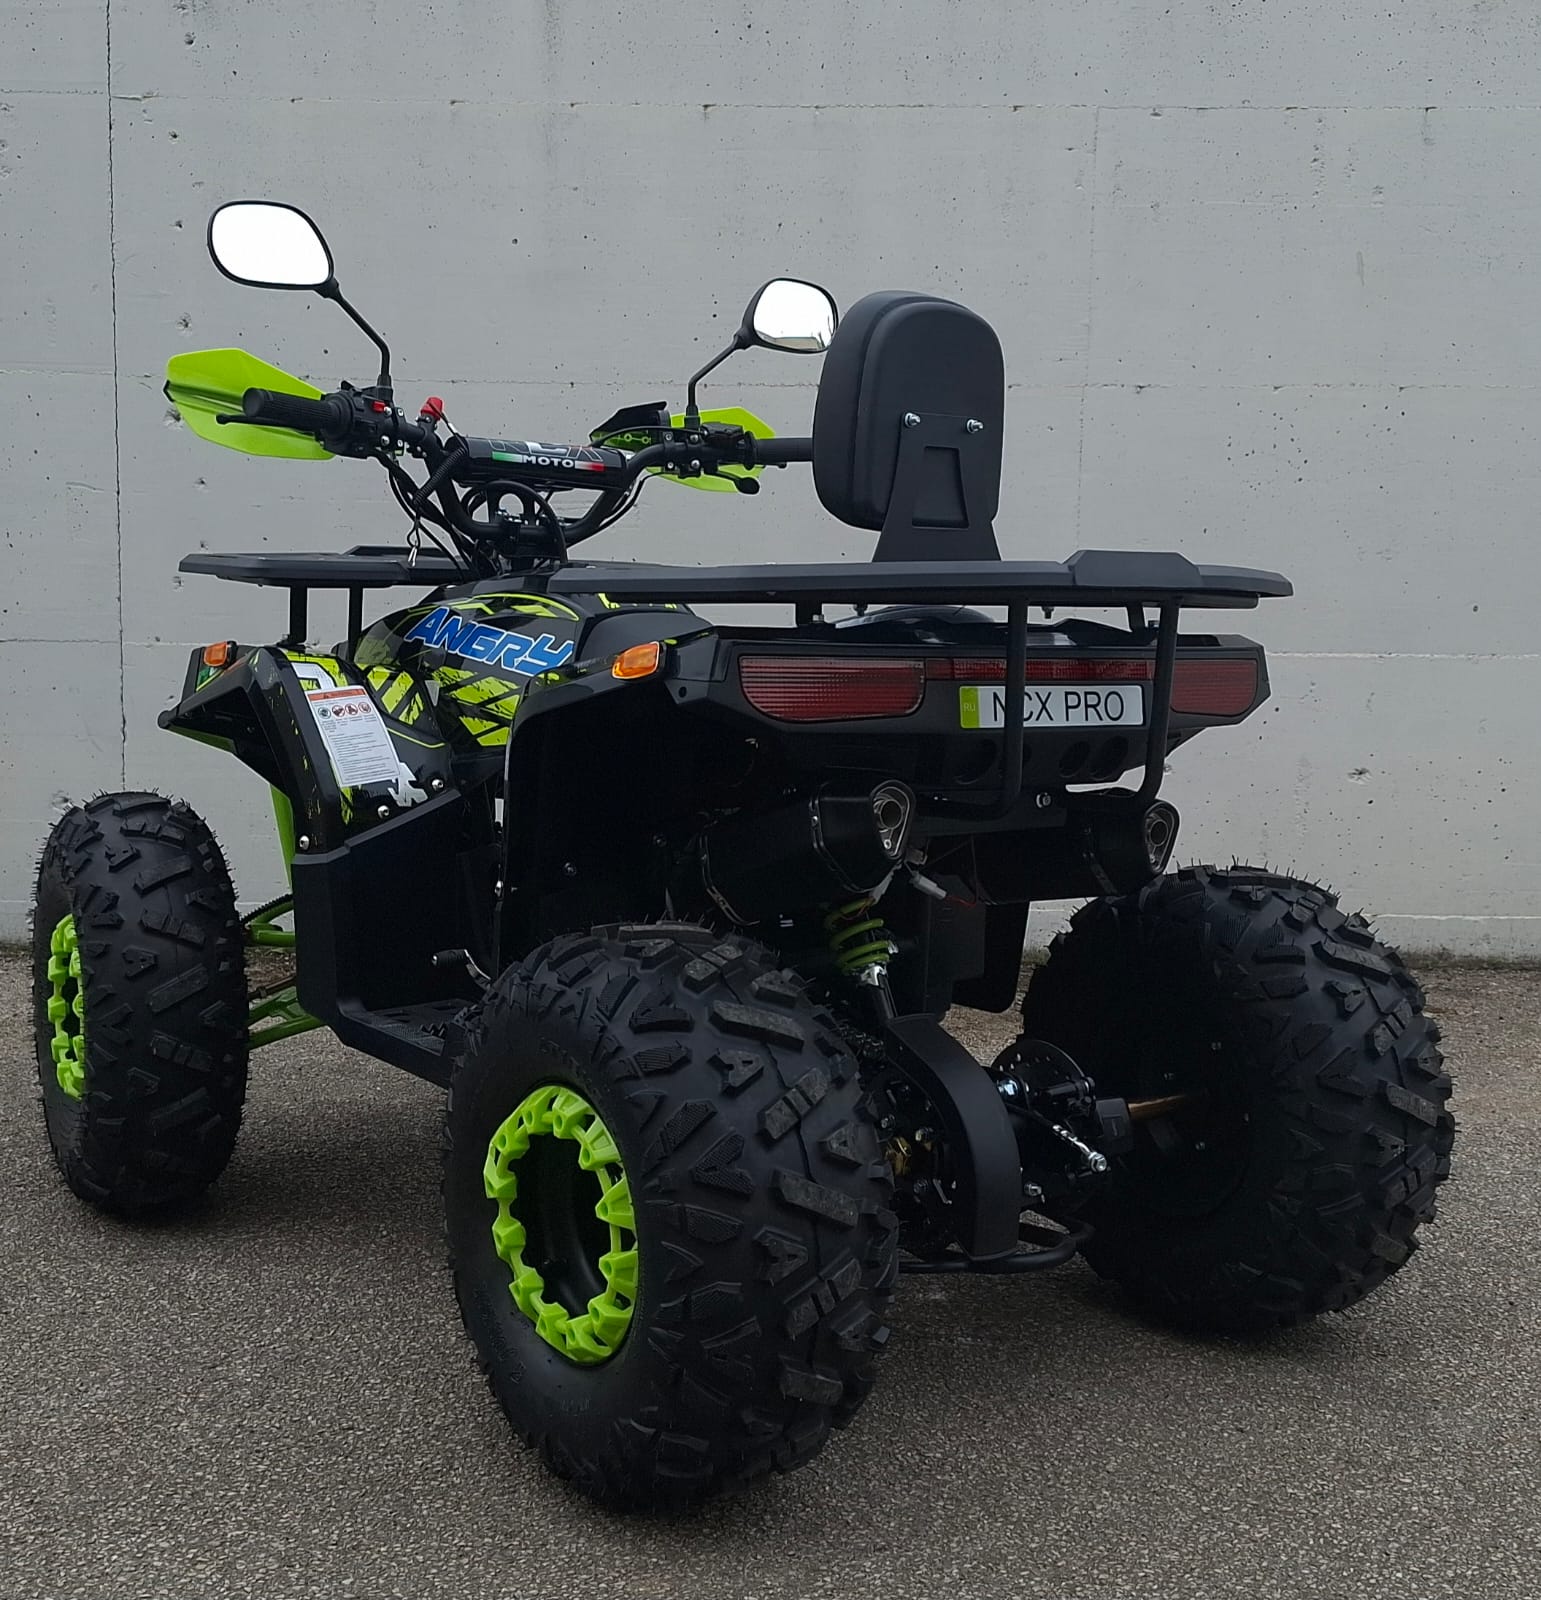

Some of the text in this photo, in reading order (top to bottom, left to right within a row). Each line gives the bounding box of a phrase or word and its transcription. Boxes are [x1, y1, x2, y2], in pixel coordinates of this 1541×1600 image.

[522, 455, 575, 468] MOTO
[404, 606, 574, 677] ANGRY
[1064, 691, 1125, 721] PRO
